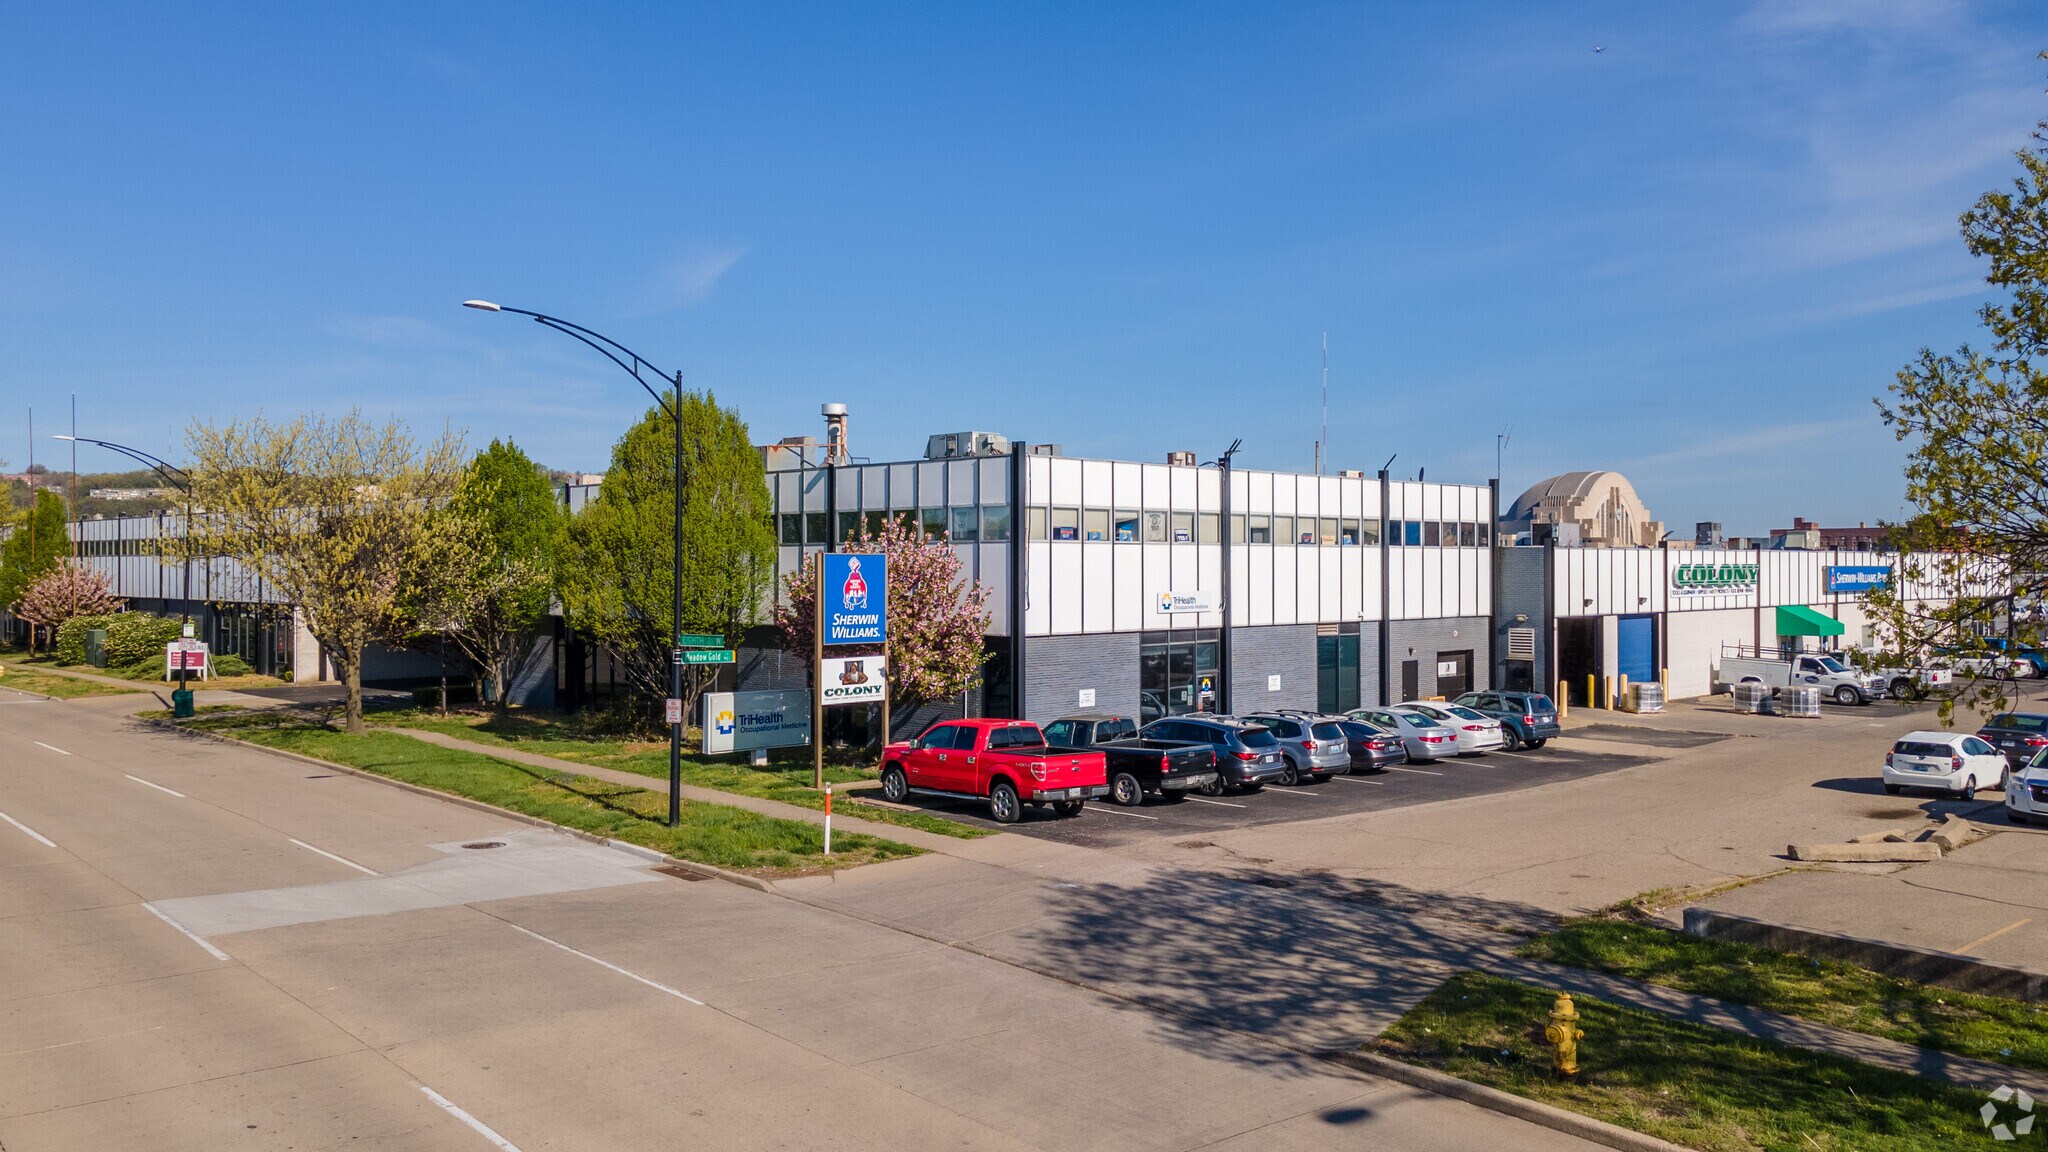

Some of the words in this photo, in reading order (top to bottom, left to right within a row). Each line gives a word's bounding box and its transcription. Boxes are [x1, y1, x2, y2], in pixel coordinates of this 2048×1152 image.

[1677, 563, 1759, 585] COLONY
[1173, 596, 1197, 605] TriHealth
[832, 612, 879, 626] SHERWIN
[682, 635, 705, 645] EIGHTH
[708, 652, 721, 661] Gold
[824, 684, 883, 698] COLONY
[739, 711, 784, 726] TriHealth
[740, 724, 780, 734] Occupational
[781, 721, 808, 730] Medicine
